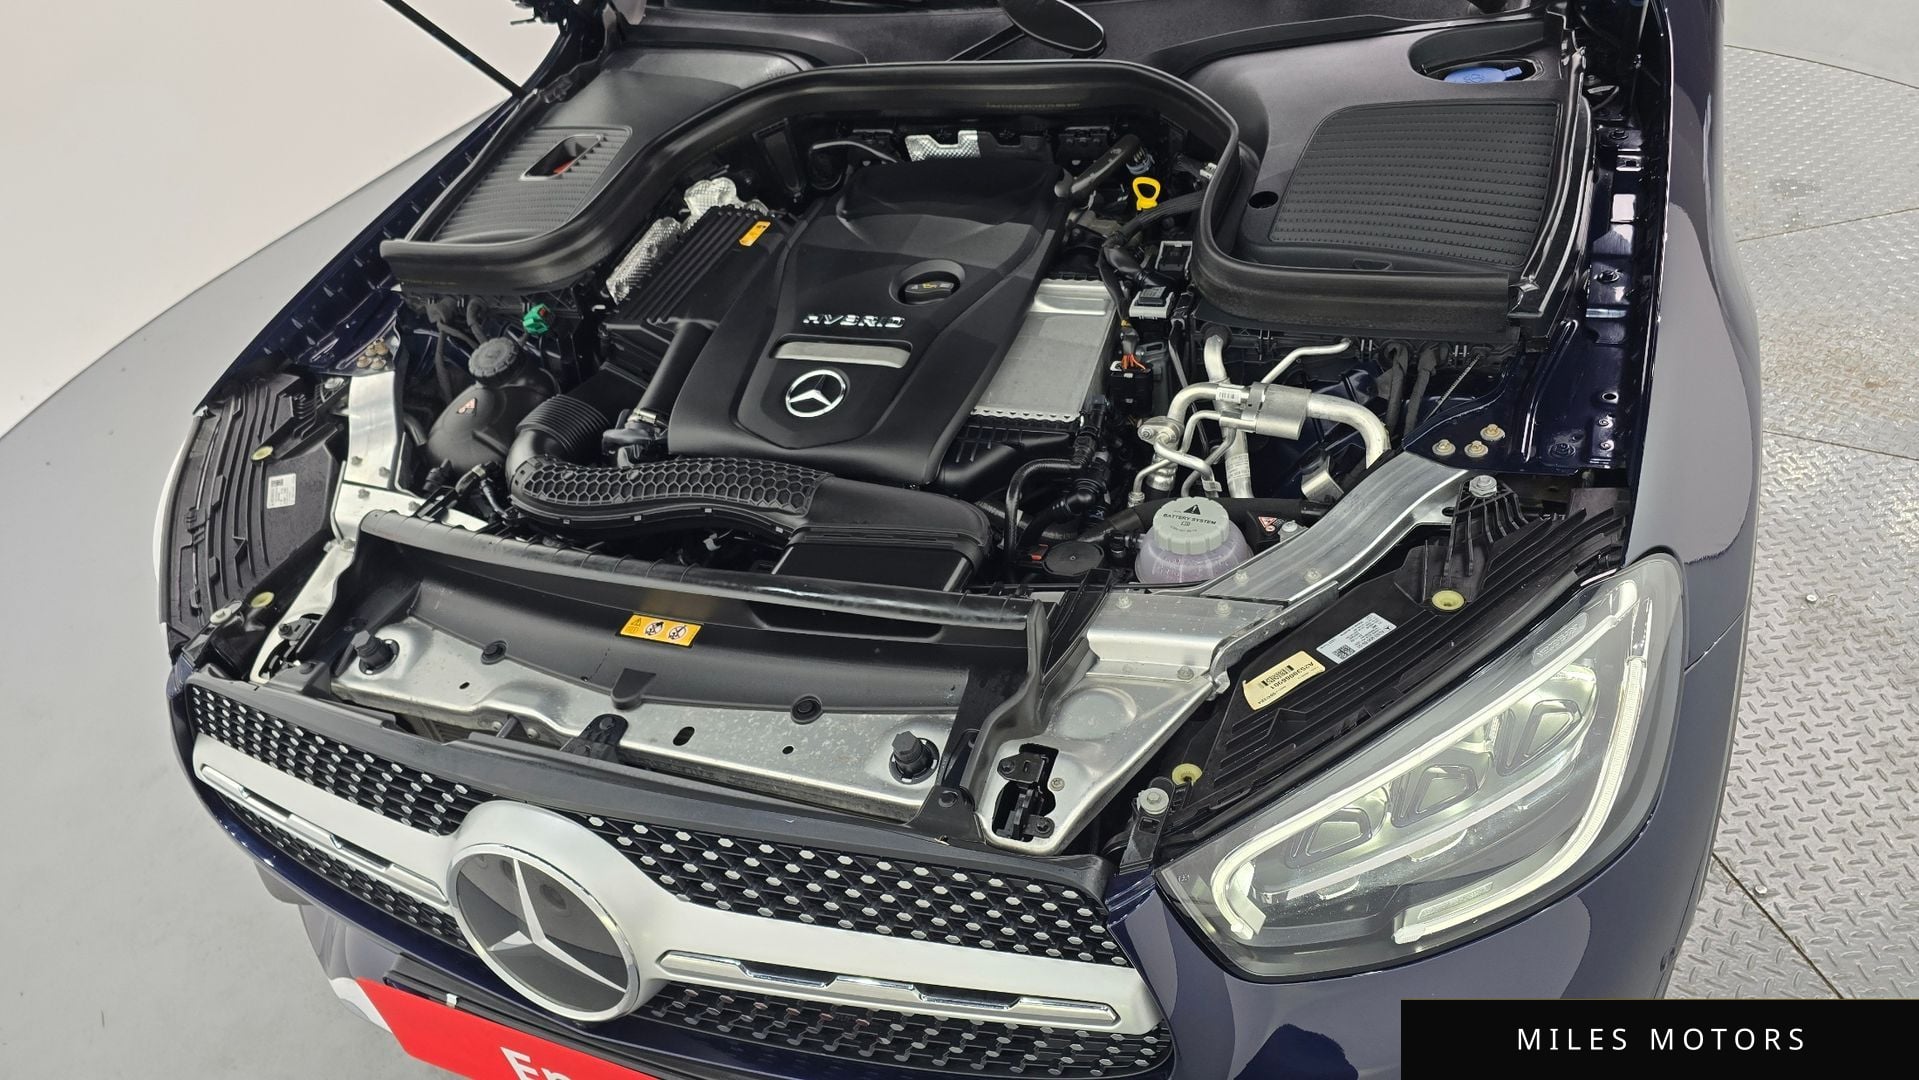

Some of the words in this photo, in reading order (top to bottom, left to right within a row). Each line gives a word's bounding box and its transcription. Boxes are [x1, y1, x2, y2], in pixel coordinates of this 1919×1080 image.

[802, 314, 905, 328] HYBRID
[1163, 513, 1190, 521] BATTERY
[1191, 517, 1217, 525] SYSTEM
